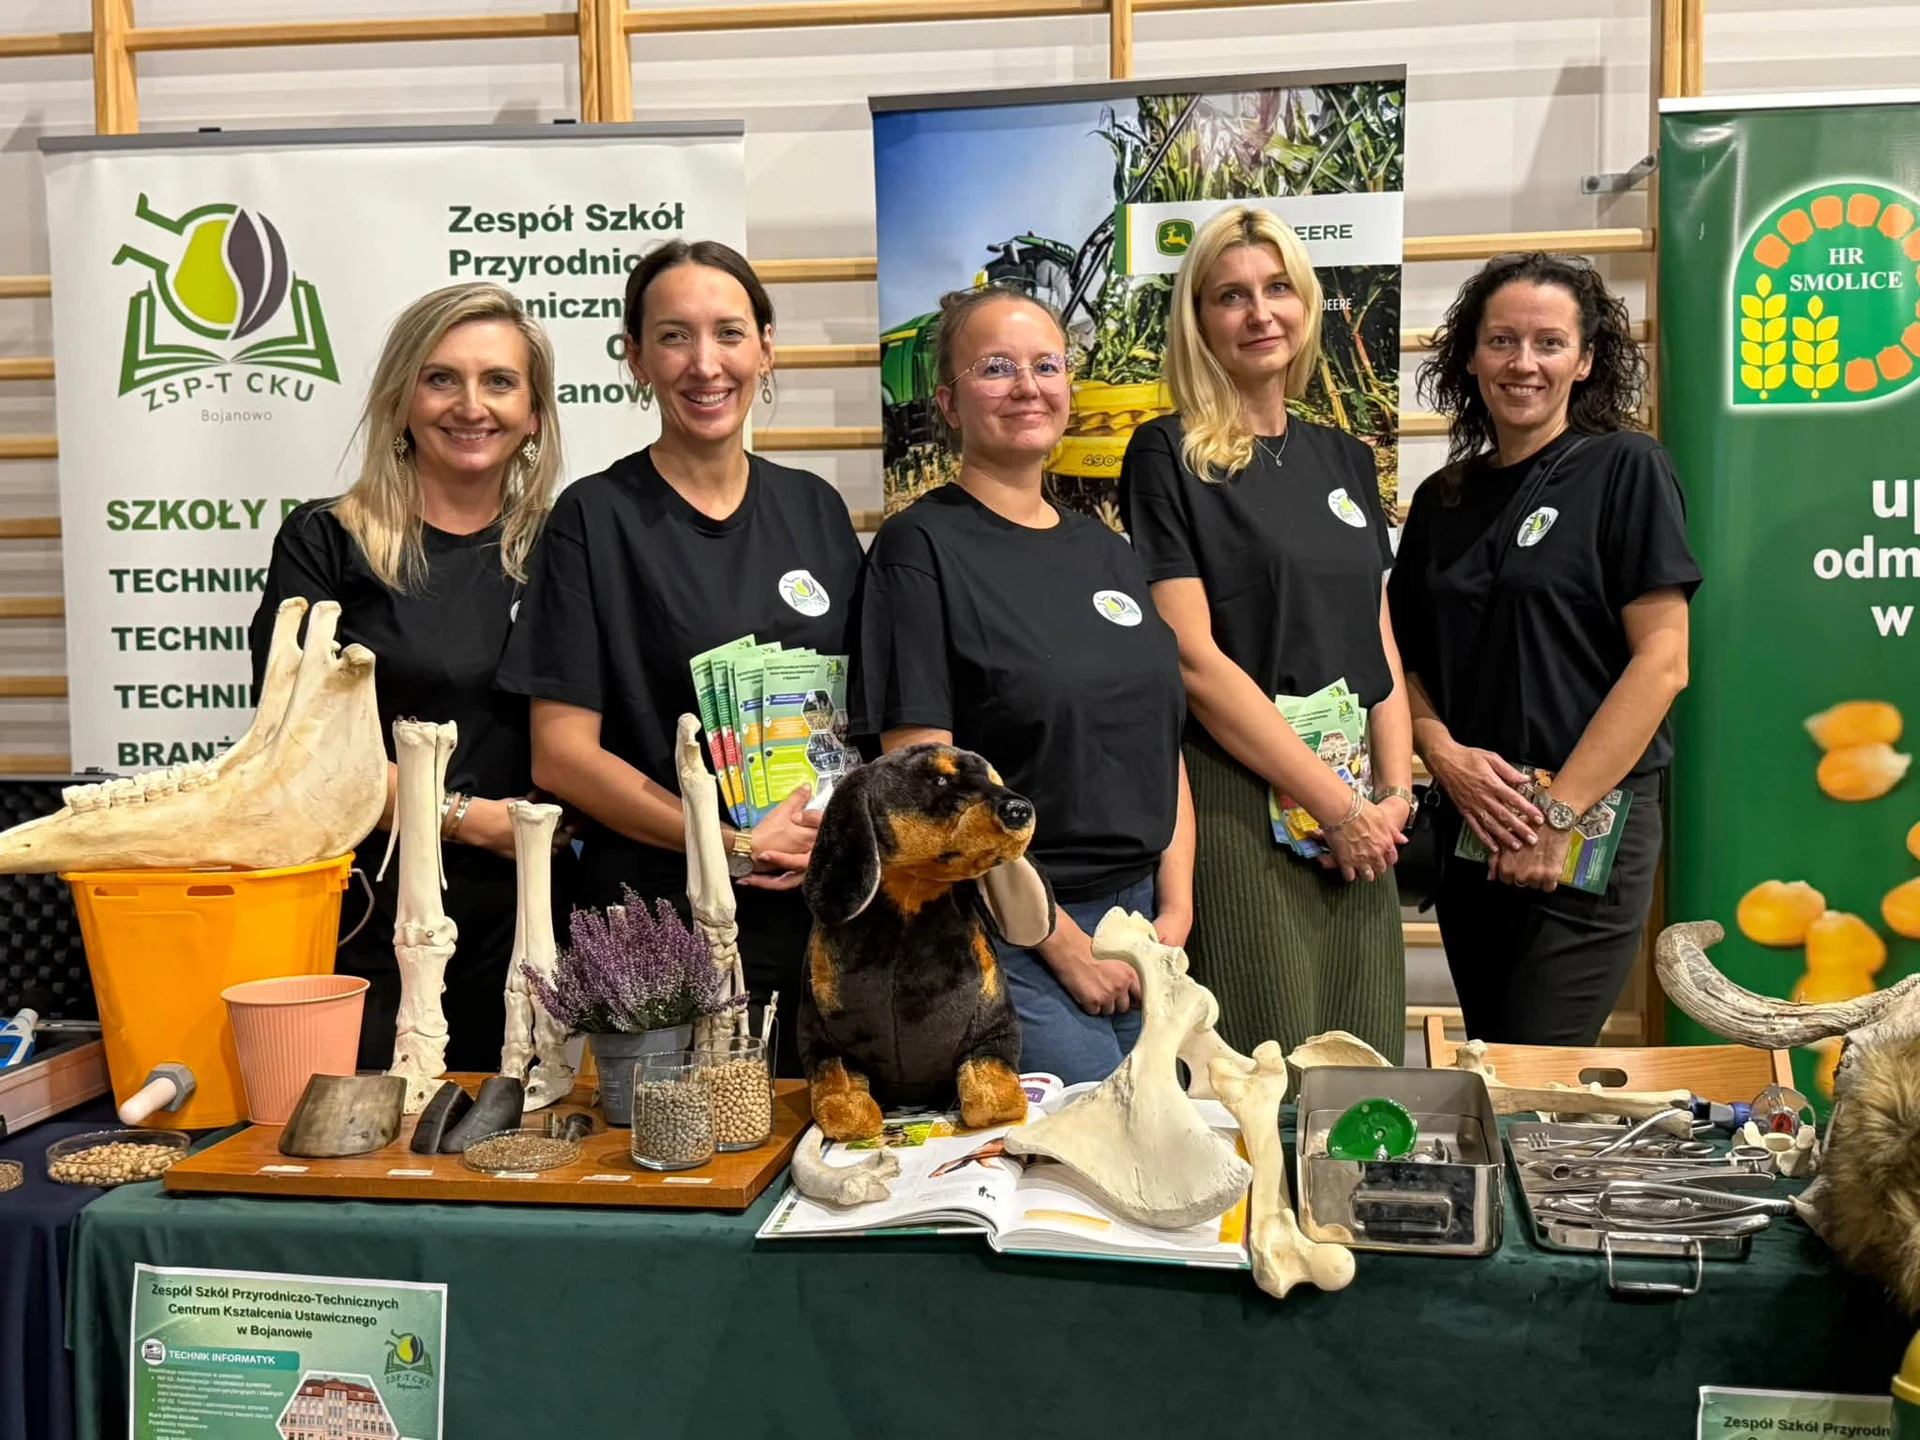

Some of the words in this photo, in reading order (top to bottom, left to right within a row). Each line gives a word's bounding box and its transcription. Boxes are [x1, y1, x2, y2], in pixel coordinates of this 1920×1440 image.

[449, 205, 574, 239] Zespół
[585, 203, 685, 232] Szkół
[1828, 247, 1865, 266] HR
[1789, 271, 1904, 292] SMOLICE
[141, 372, 233, 413] ZSP-T
[246, 372, 315, 402] CKU
[201, 409, 272, 424] Bojanowo
[106, 498, 268, 531] SZKOŁY
[109, 567, 267, 593] TECHNIK
[1871, 605, 1915, 637] w
[111, 626, 252, 651] TECHNI
[151, 1283, 193, 1299] Zespół
[195, 1285, 229, 1299] Szkół
[232, 1288, 399, 1311] Przyrodniczo-Technicznych
[168, 1303, 220, 1316] Centrum
[223, 1305, 292, 1321] Kształcenia
[294, 1310, 378, 1328] Ustawicznego
[237, 1326, 248, 1335] w
[250, 1325, 313, 1339] Bojanowie
[169, 1350, 210, 1361] TECHNIK
[212, 1352, 276, 1365] INFORMATYK
[1723, 1416, 1773, 1432] Zespół
[1777, 1419, 1819, 1433] Szkół
